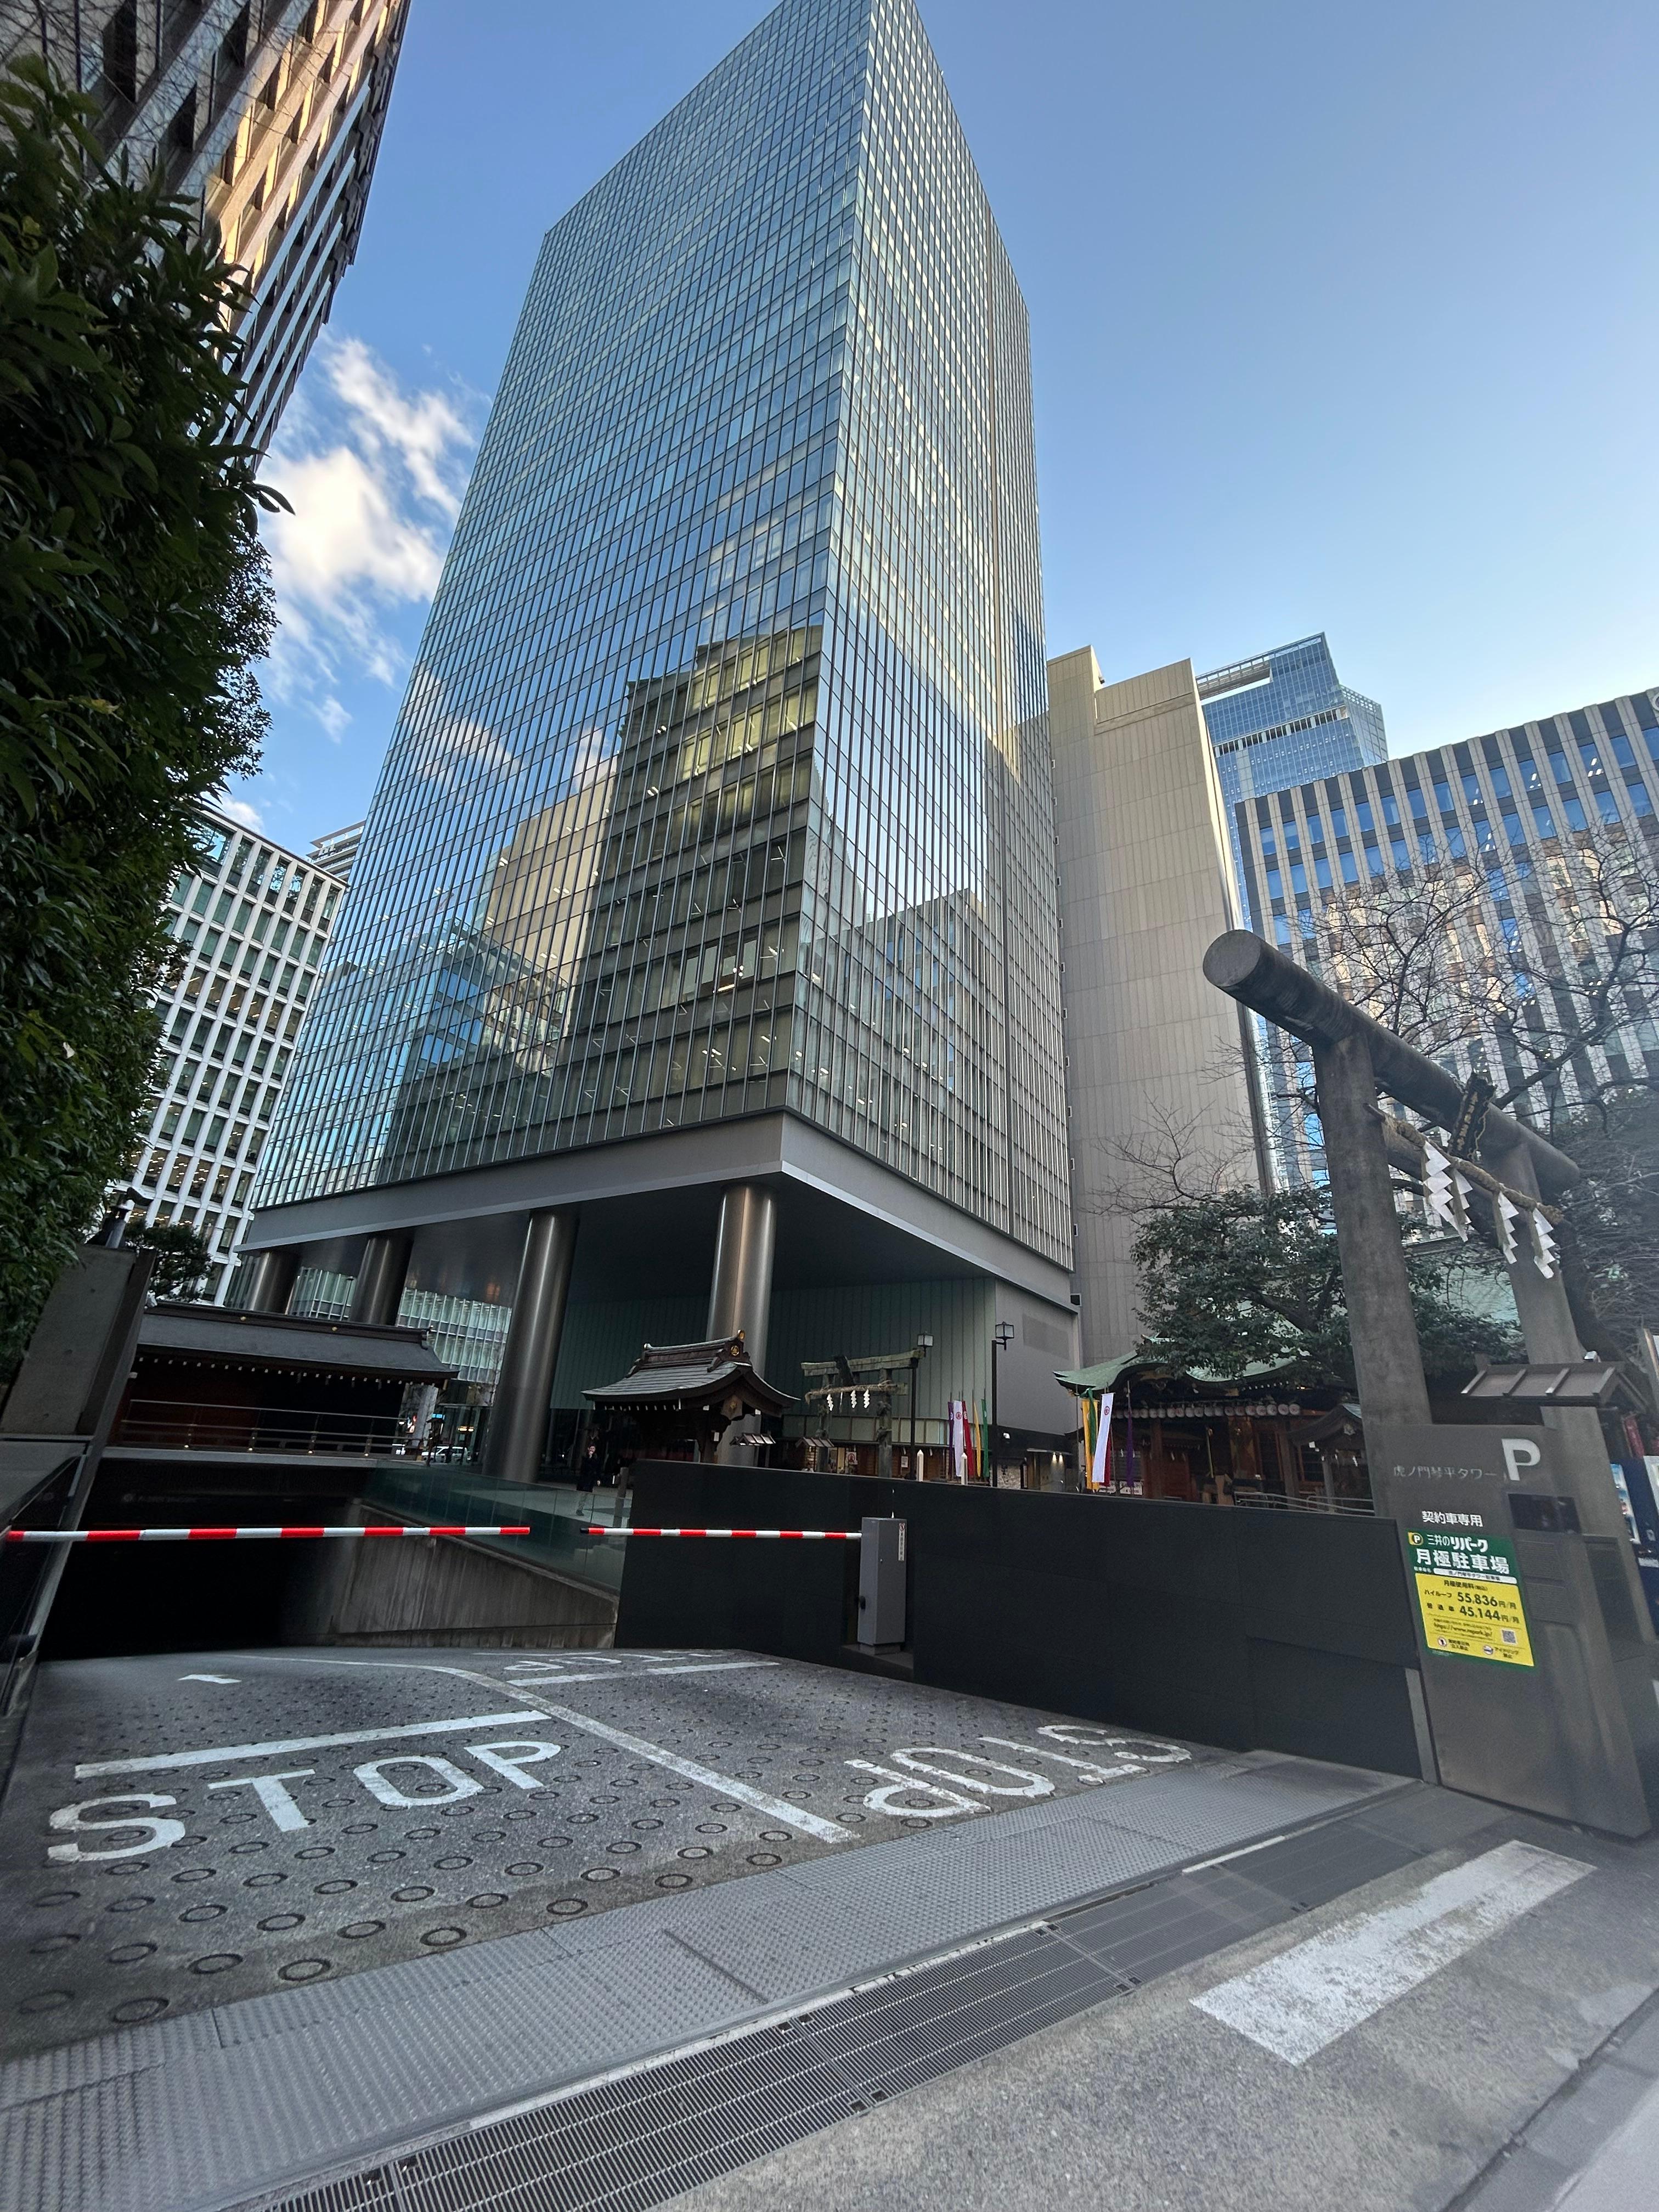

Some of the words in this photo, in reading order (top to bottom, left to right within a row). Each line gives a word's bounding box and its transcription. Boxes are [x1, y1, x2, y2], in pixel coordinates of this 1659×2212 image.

[1502, 1438, 1541, 1481] P
[1422, 1511, 1483, 1527] 契約車専用
[1427, 1534, 1488, 1553] 三井のリパーク
[1417, 1548, 1509, 1574] 月極駐車場
[844, 1725, 1192, 1817] STOP
[47, 1741, 561, 1861] STOP
